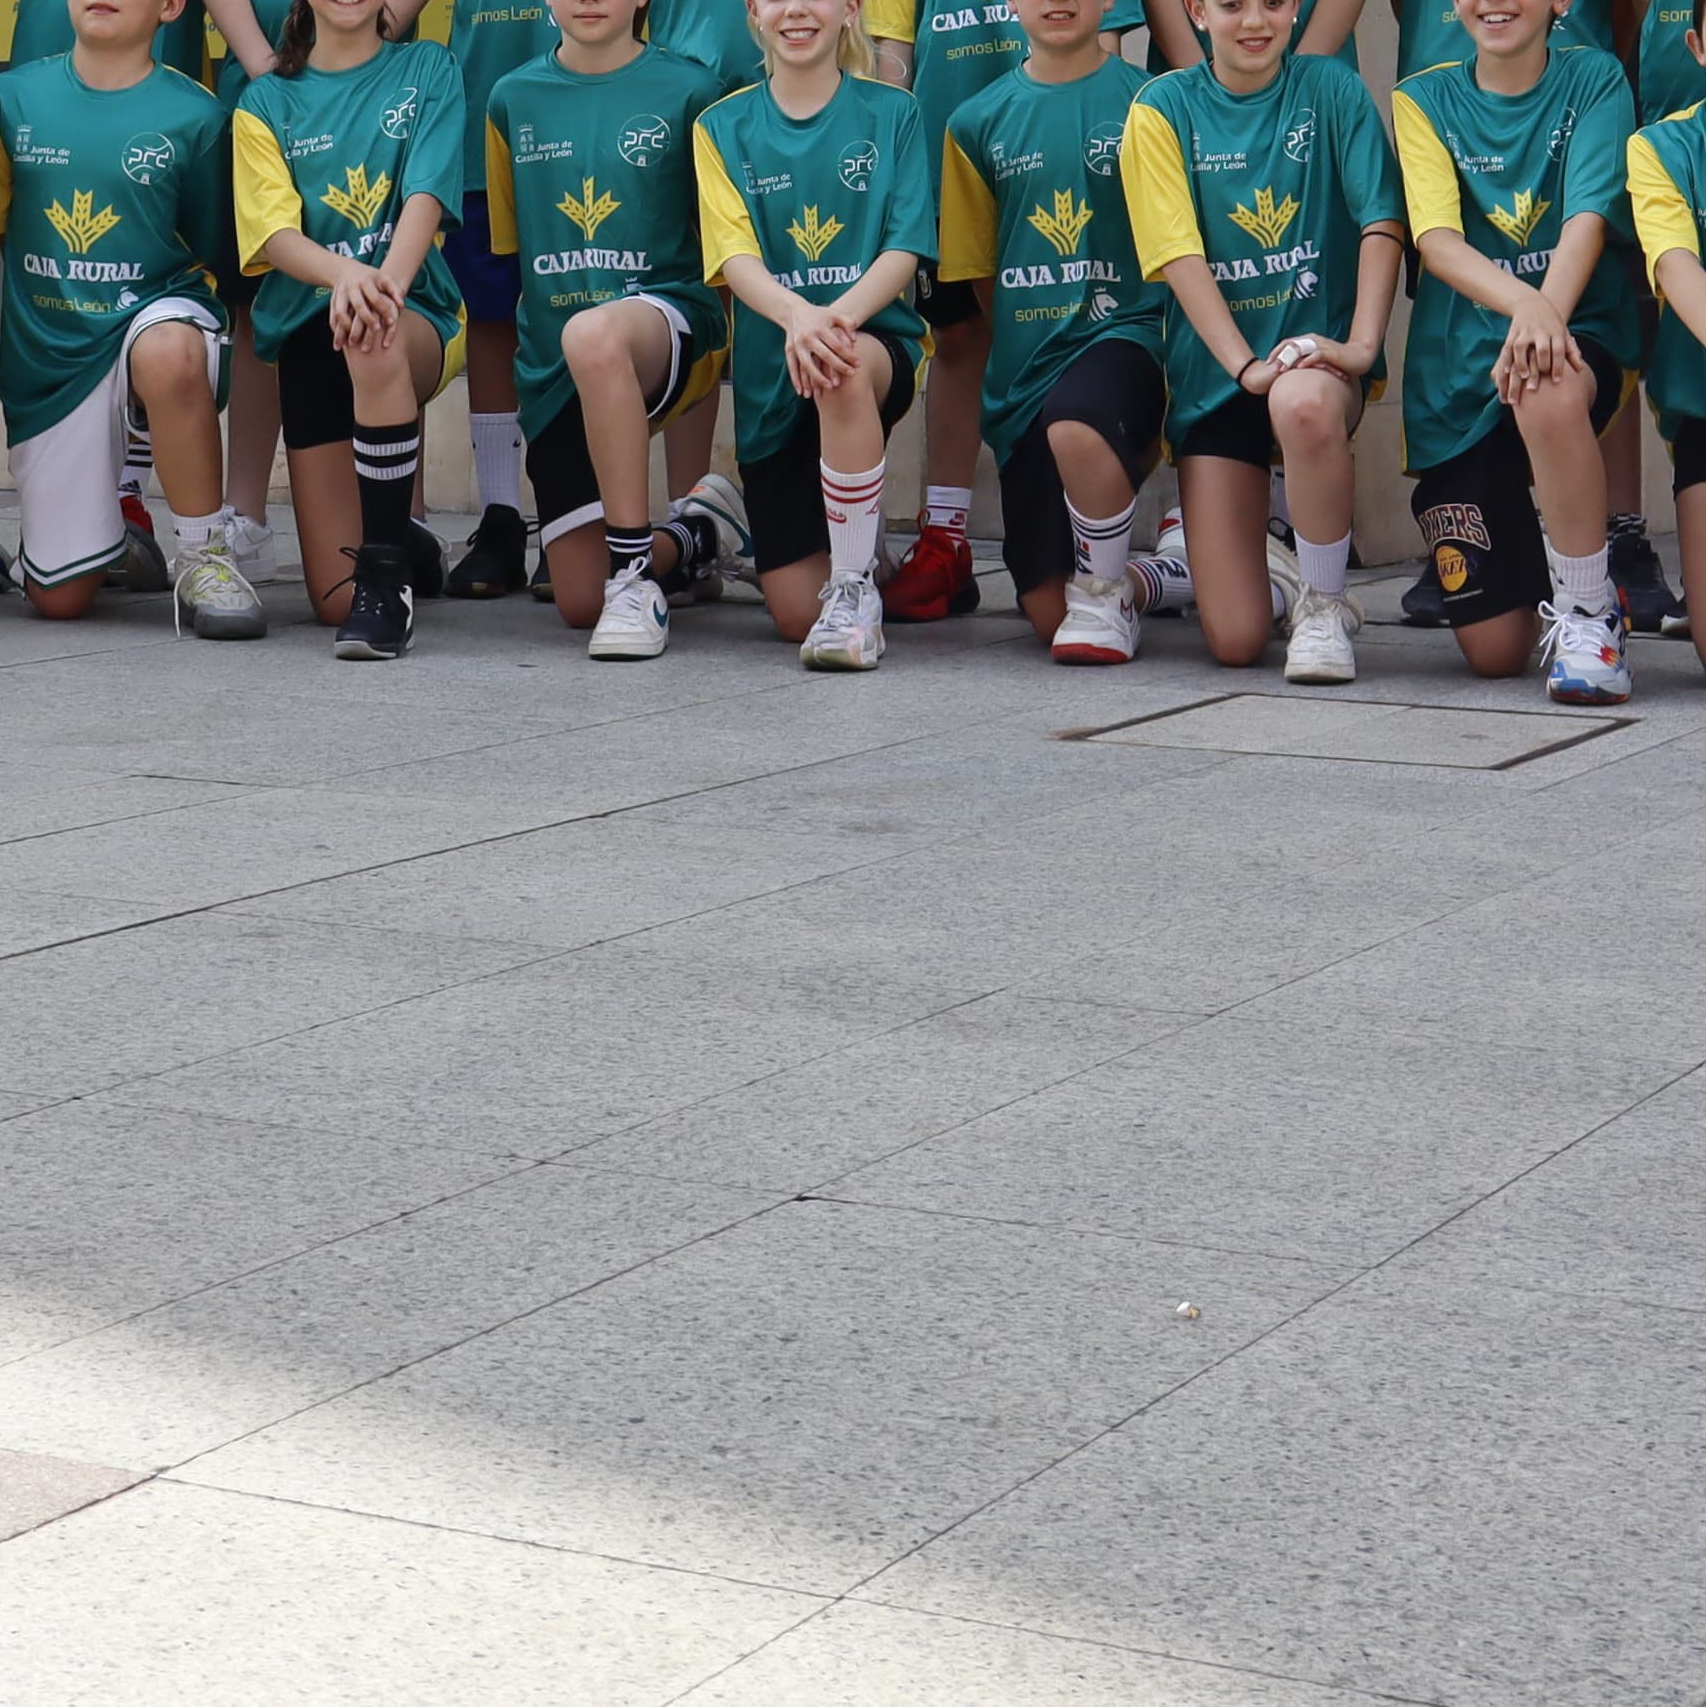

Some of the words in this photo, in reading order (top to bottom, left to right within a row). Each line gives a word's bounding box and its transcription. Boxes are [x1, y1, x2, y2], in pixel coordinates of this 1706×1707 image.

[933, 8, 980, 32] CAJA
[24, 253, 61, 280] CAJA
[68, 260, 145, 282] RURAL
[582, 248, 653, 271] RURAL
[1002, 265, 1057, 289] CAJA
